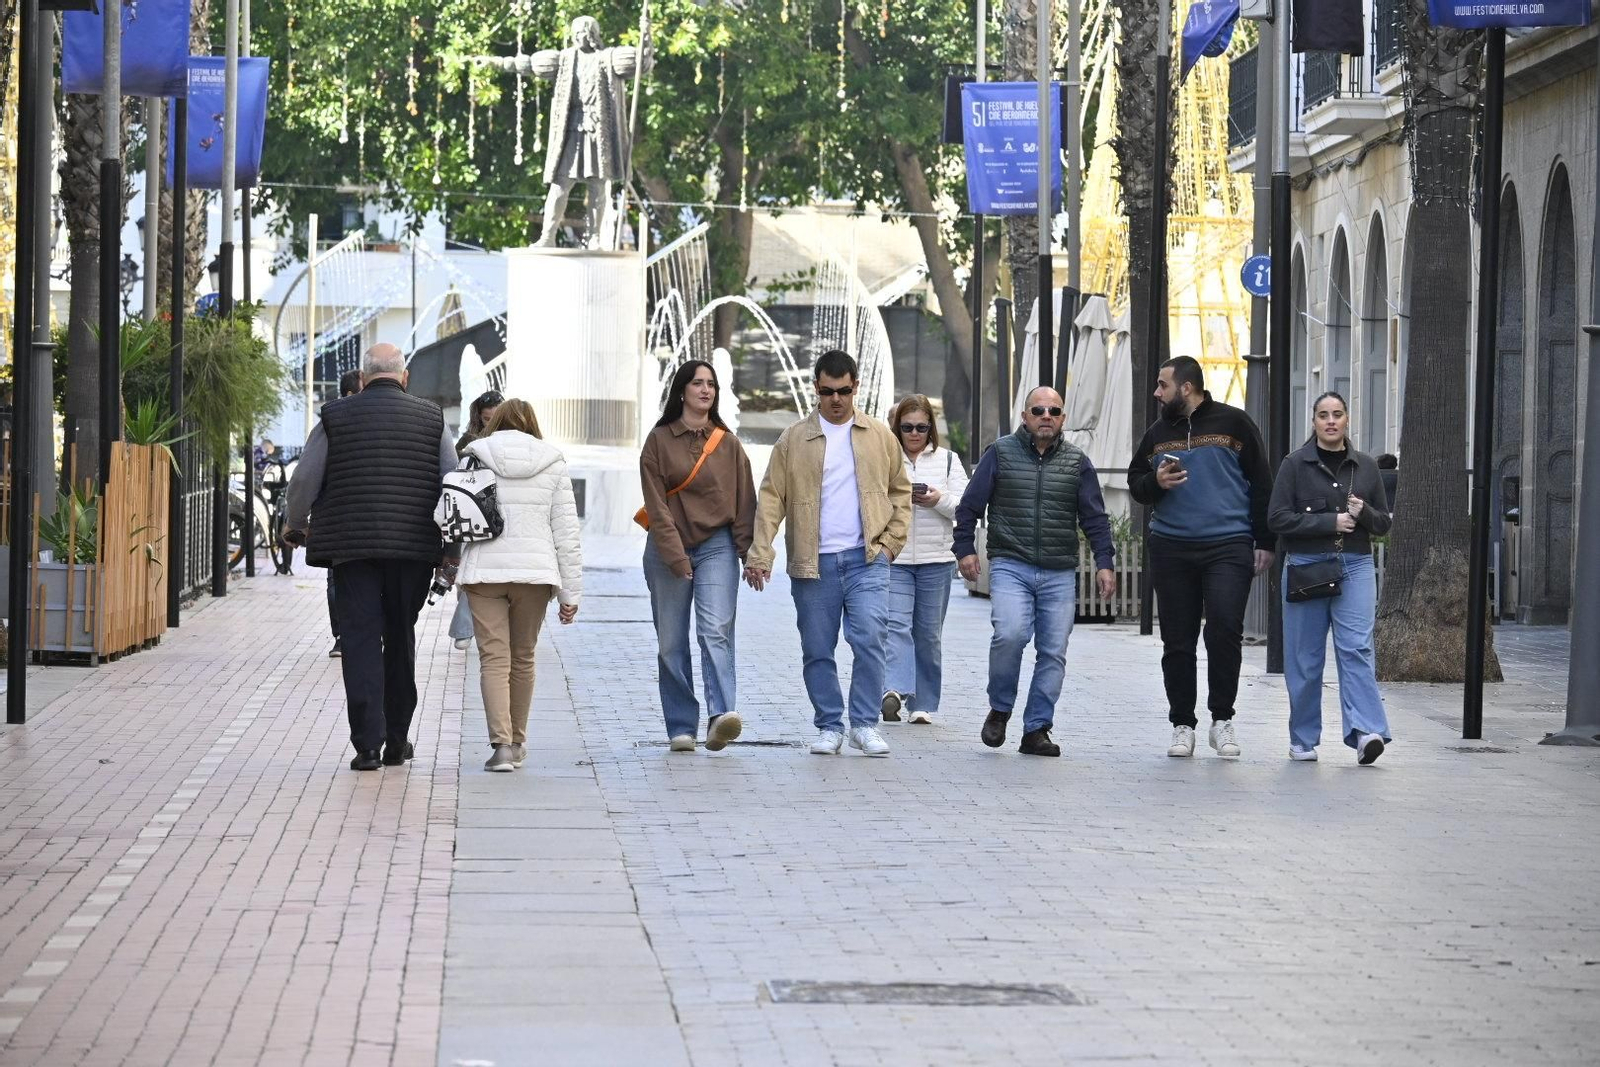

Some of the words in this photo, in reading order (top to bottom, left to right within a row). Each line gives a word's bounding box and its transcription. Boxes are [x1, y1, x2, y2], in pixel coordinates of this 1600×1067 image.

[1454, 4, 1545, 16] WWW.FESTICINEHUELVA.COM
[988, 101, 1014, 110] FESTIVAL
[1016, 101, 1023, 110] DE
[1024, 101, 1039, 110] HUEL
[972, 101, 986, 127] 51
[988, 111, 1001, 120] CINE
